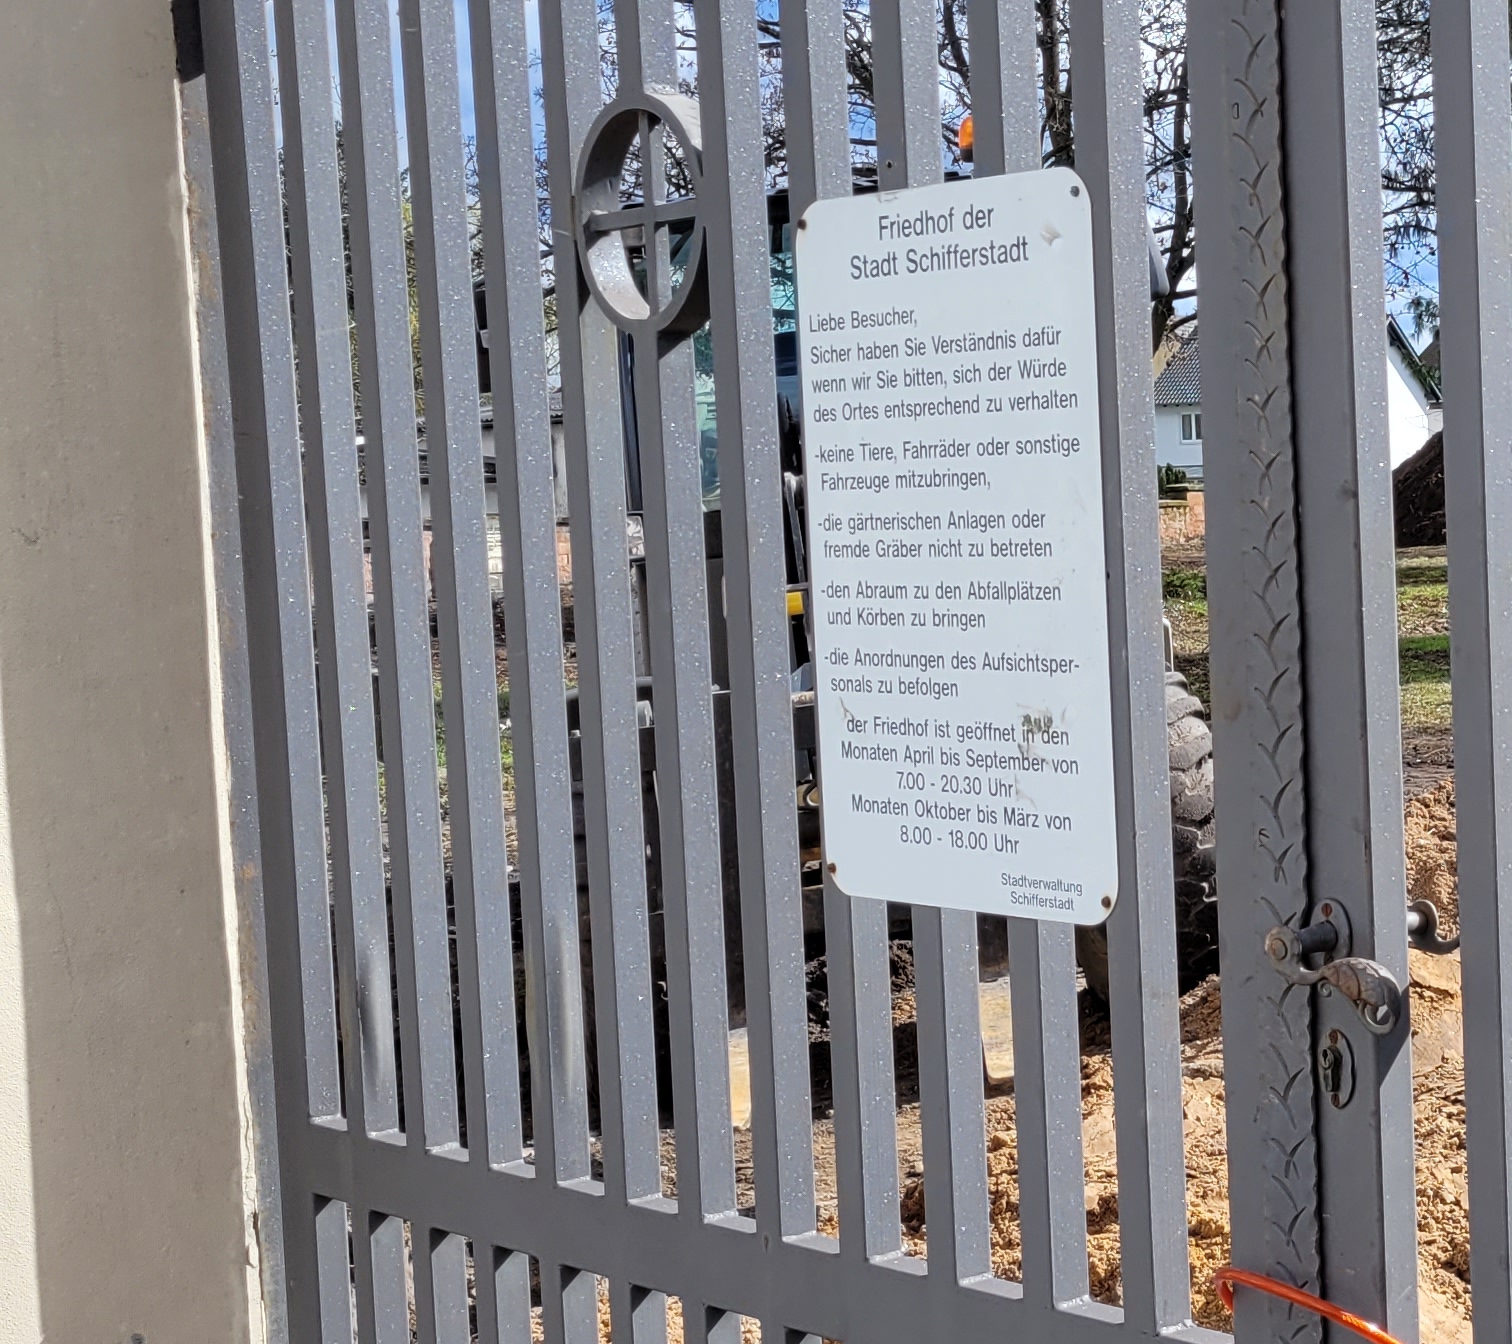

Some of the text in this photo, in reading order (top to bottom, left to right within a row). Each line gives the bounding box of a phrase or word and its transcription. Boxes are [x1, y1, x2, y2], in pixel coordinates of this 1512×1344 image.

[878, 203, 995, 241] Friedhof der
[850, 235, 1030, 281] Stadt Schifferstadt
[809, 306, 918, 333] Liebe Besucher,
[810, 325, 1062, 365] Sicher haben Sie Verständnis dafür
[811, 357, 1067, 394] wenn wir Sie bitten, sich der Würde
[813, 389, 1078, 423] des Ortes entsprechend zu verhalten
[814, 433, 1081, 464] -keine Tiere, Fahrräder oder sonstige
[820, 467, 991, 494] Fahrzeuge mitzubringen,
[817, 508, 1046, 536] -die gärtnerischen Anlagen oder
[823, 537, 1053, 559] fremde Gräber nicht zu betreten
[820, 580, 1062, 605] -den Abraum zu den Abfallplätzen
[827, 606, 986, 632] und Körben zu bringen
[824, 647, 1080, 678] -die Anordnungen des Aufsichtsper-
[830, 674, 959, 701] sonals zu befolgen
[847, 715, 1070, 746] der Friedhof ist geöffnet in den
[841, 740, 1079, 775] Monaten April bis September von
[895, 770, 926, 791] 7.00
[940, 774, 982, 796] 20.30
[987, 777, 1014, 798] Uhr
[851, 793, 1072, 832] Monaten Oktober bis März von
[900, 824, 932, 846] 8.00
[947, 829, 988, 851] 18.00
[993, 832, 1020, 855] Uhr
[1001, 872, 1083, 897] Stadtverwaltung
[1010, 890, 1075, 911] Schifferstadt
